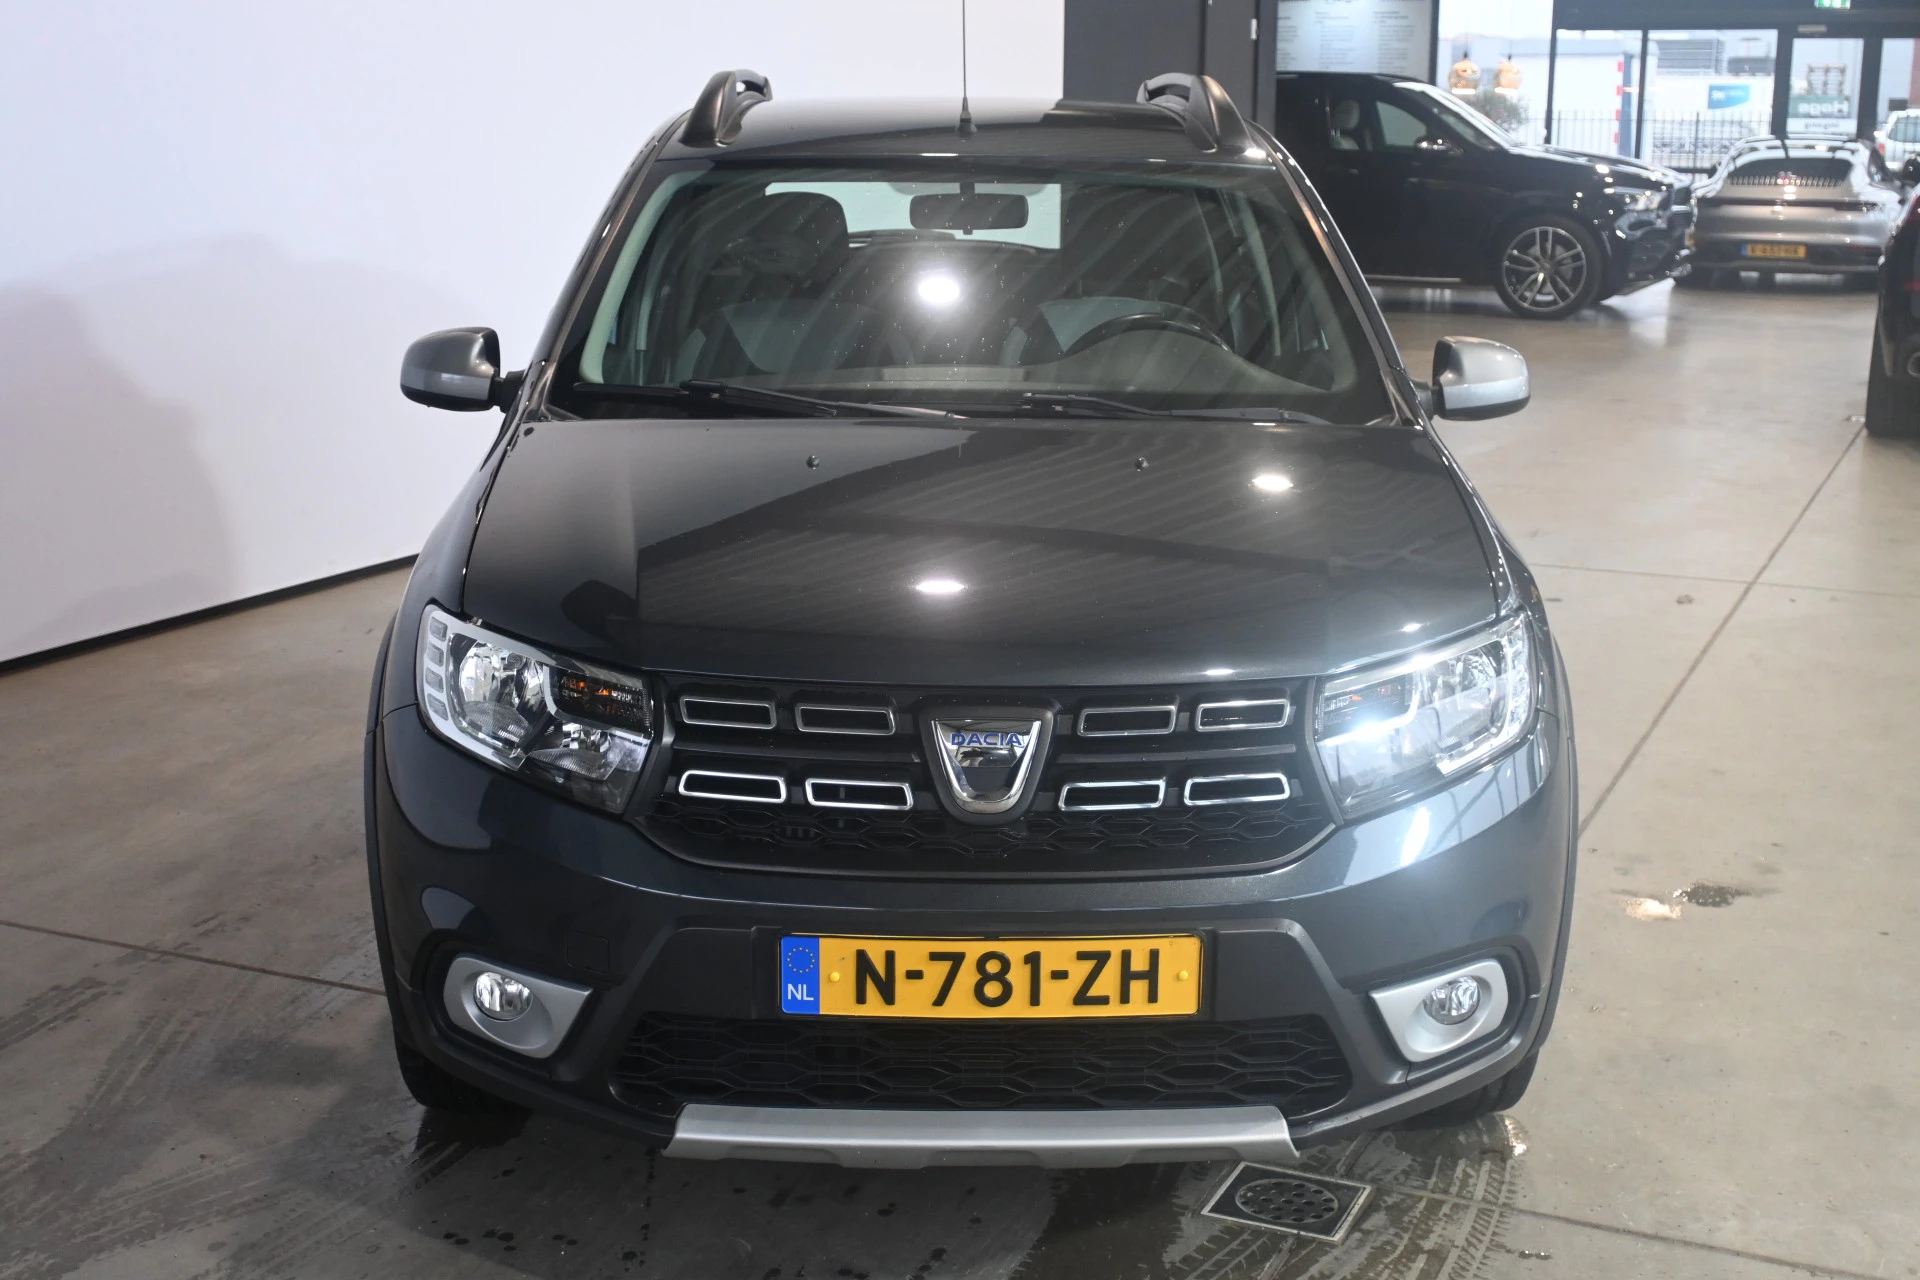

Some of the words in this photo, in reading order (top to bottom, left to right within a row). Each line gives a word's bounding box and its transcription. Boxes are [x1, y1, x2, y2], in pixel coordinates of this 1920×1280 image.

[951, 732, 1022, 746] DACIA
[855, 949, 1160, 1008] N-781-ZH
[787, 983, 815, 1001] NL
